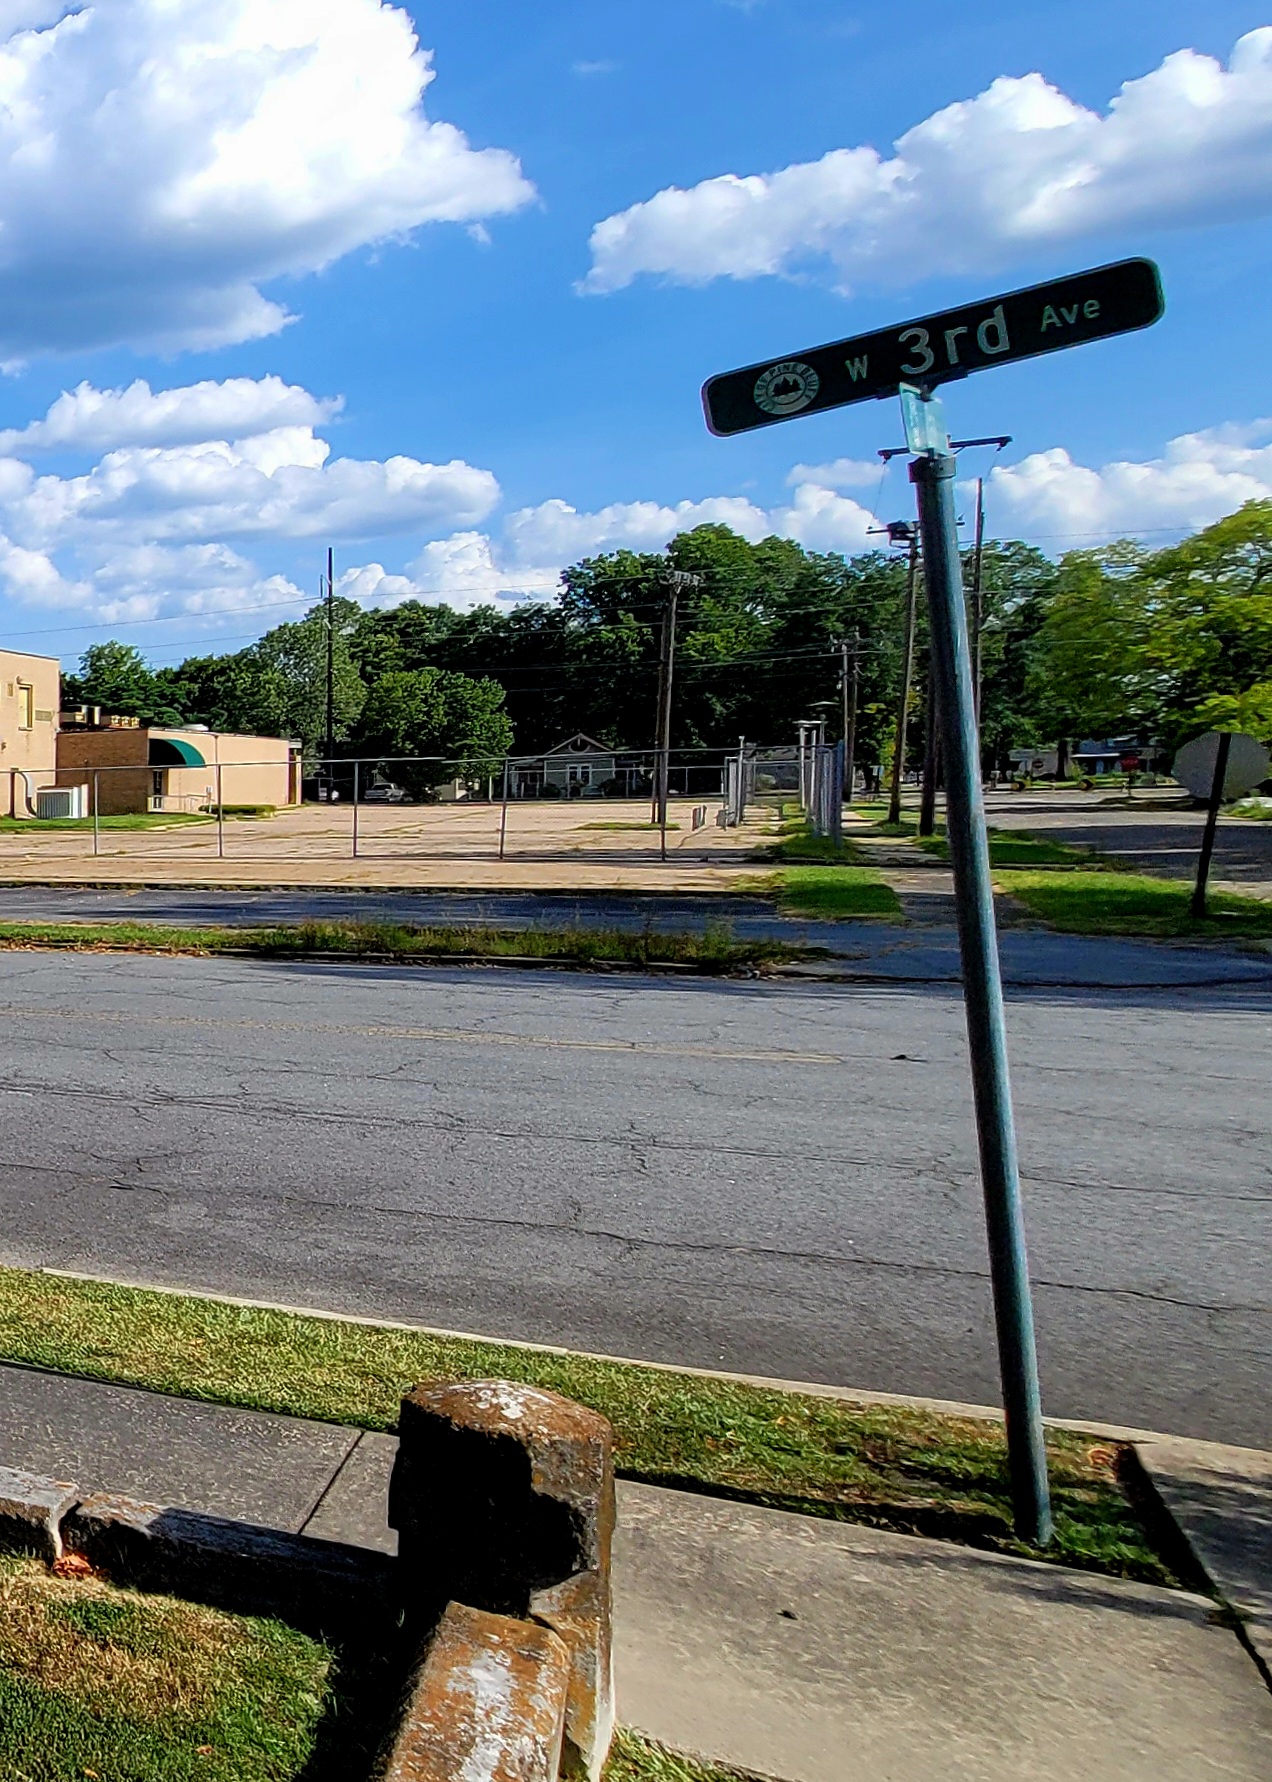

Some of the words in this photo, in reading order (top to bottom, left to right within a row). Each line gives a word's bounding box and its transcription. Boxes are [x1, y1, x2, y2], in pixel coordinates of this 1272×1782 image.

[845, 354, 868, 382] W
[898, 305, 1010, 374] 3rd
[1041, 300, 1101, 332] Ave
